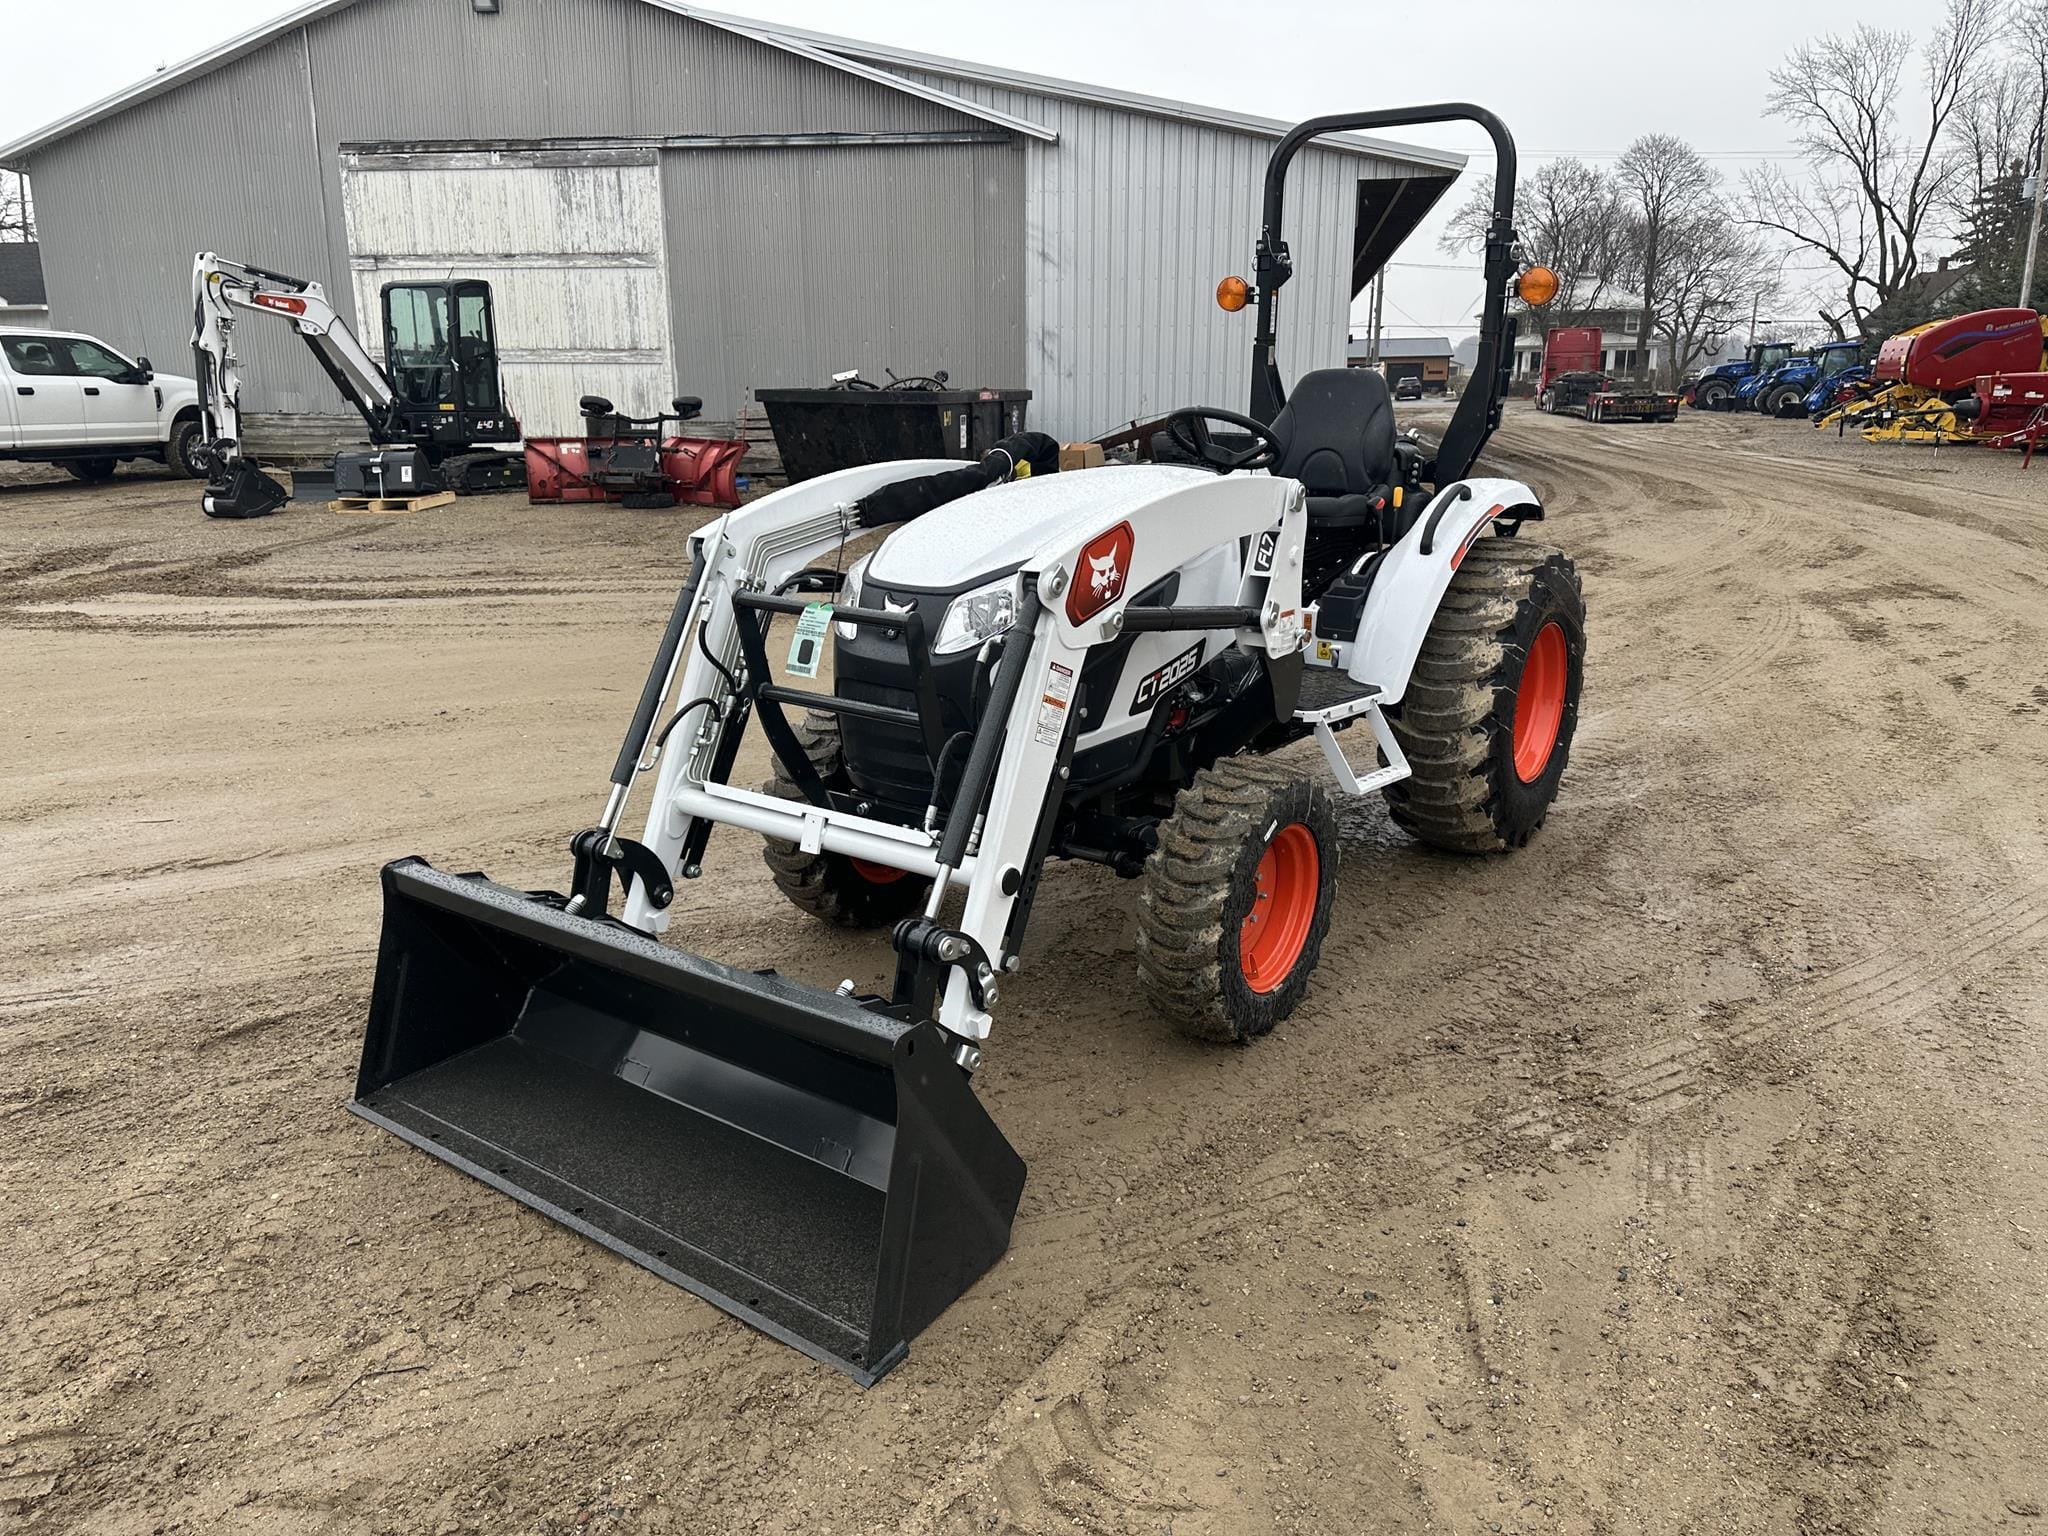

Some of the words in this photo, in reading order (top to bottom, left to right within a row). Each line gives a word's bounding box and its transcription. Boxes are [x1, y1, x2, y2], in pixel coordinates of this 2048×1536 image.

[2010, 318, 2037, 326] HOLLAND
[1257, 533, 1274, 568] FL7
[1137, 647, 1199, 704] CT2025
